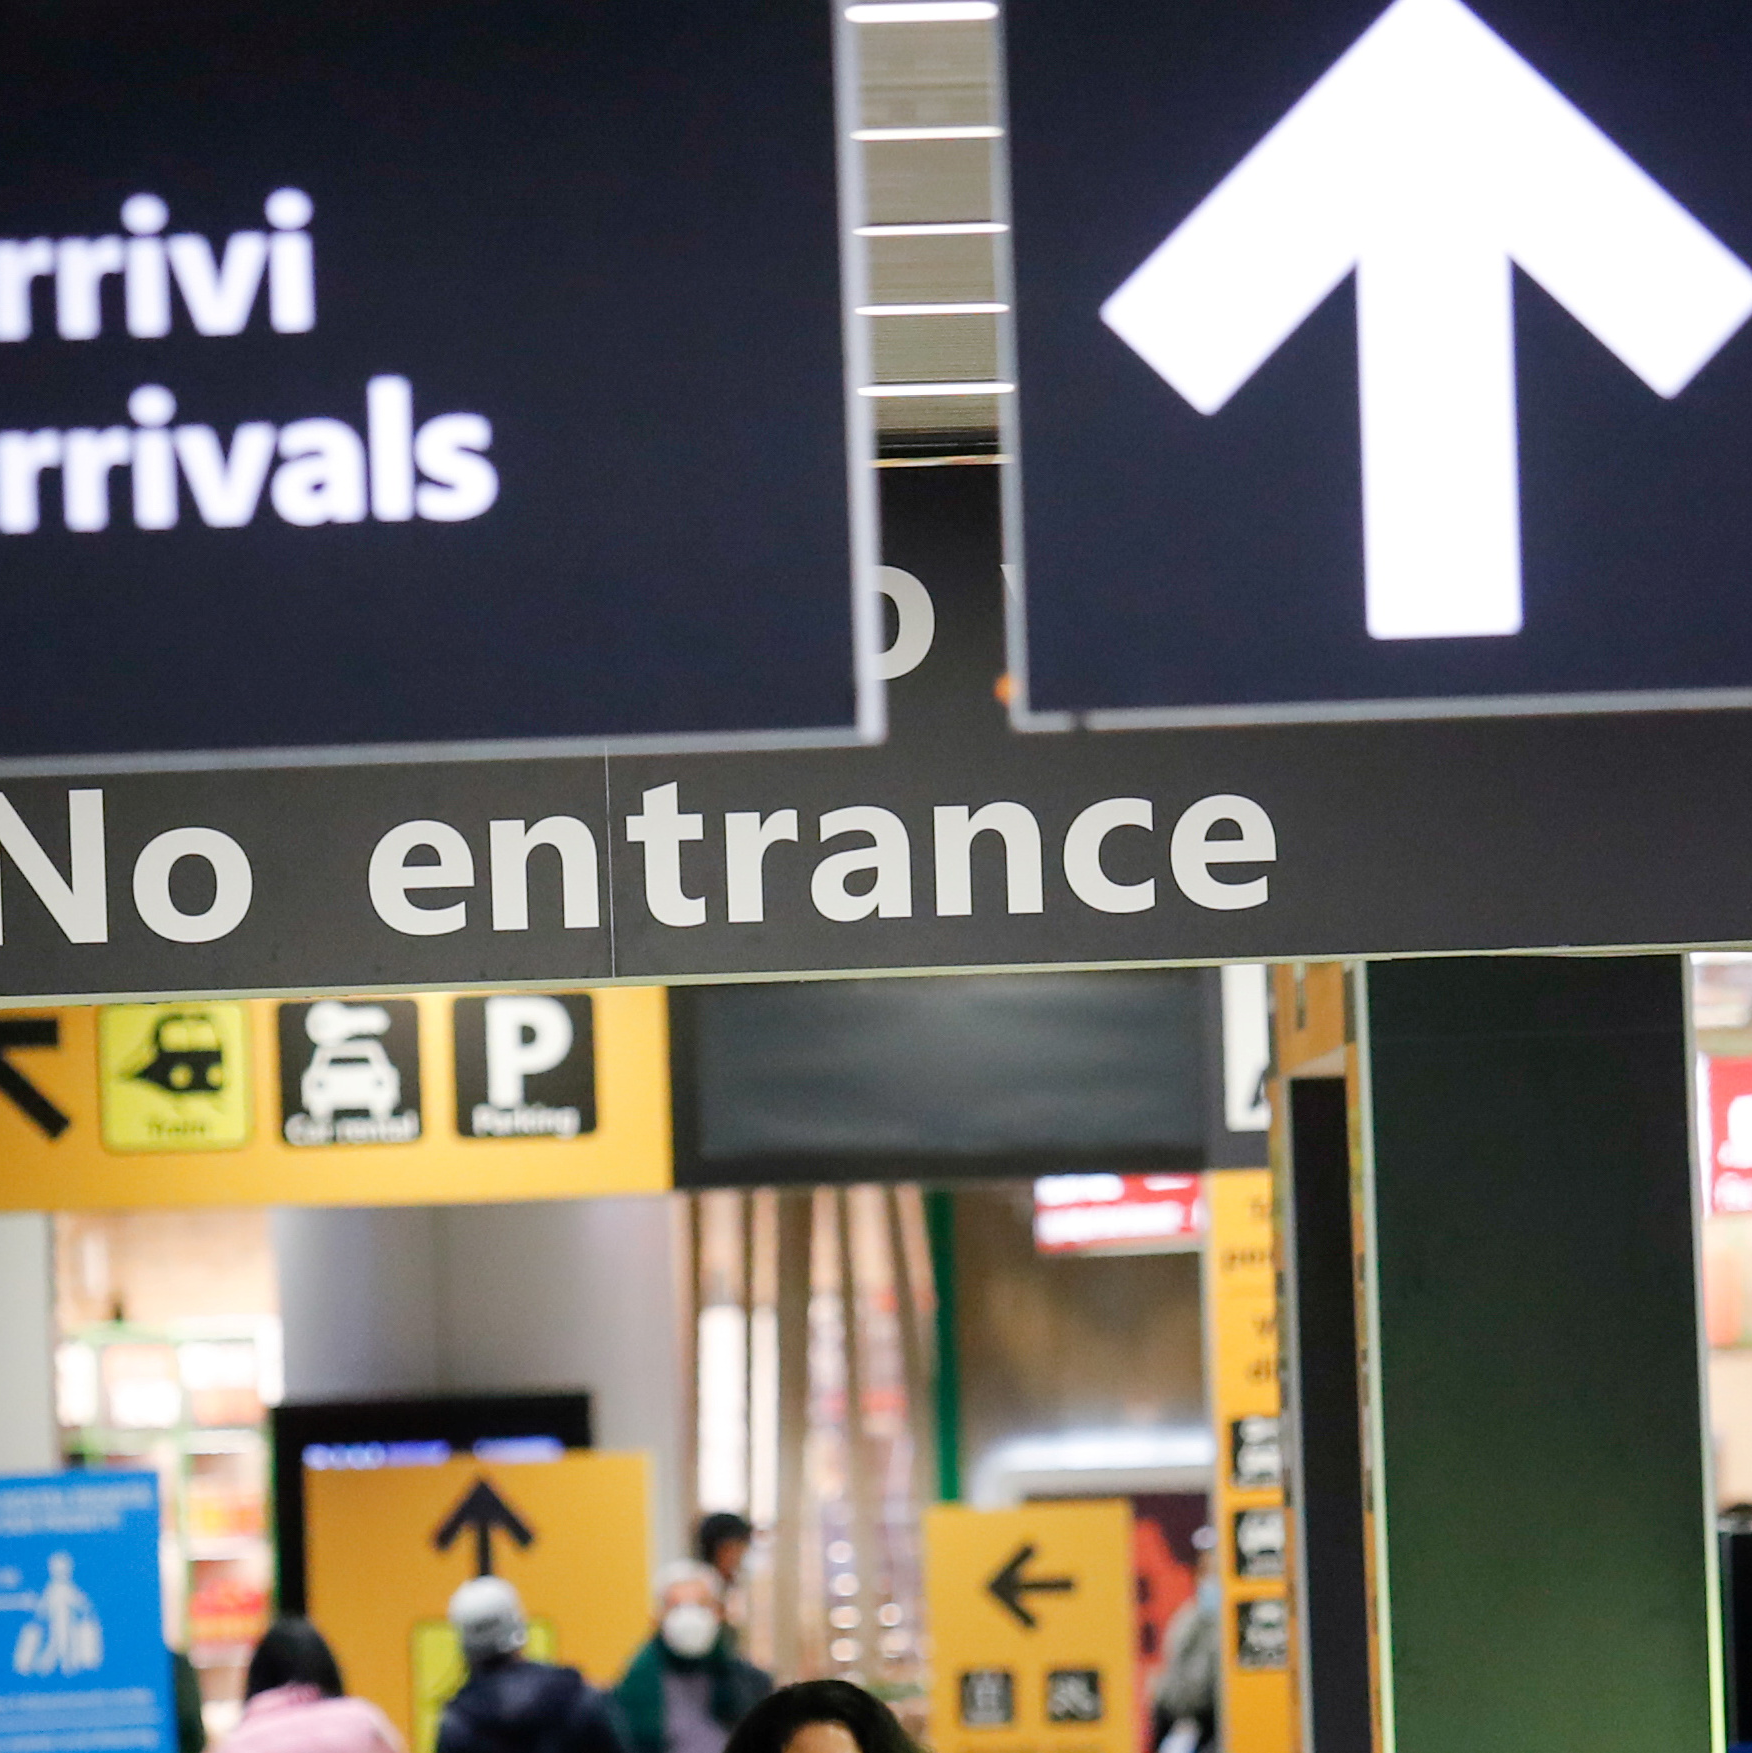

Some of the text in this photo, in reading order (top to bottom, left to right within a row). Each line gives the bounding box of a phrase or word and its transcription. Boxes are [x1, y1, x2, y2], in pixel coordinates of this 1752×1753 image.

[367, 778, 1279, 938] entrance
[484, 994, 574, 1110] P
[471, 1102, 581, 1140] Parking
